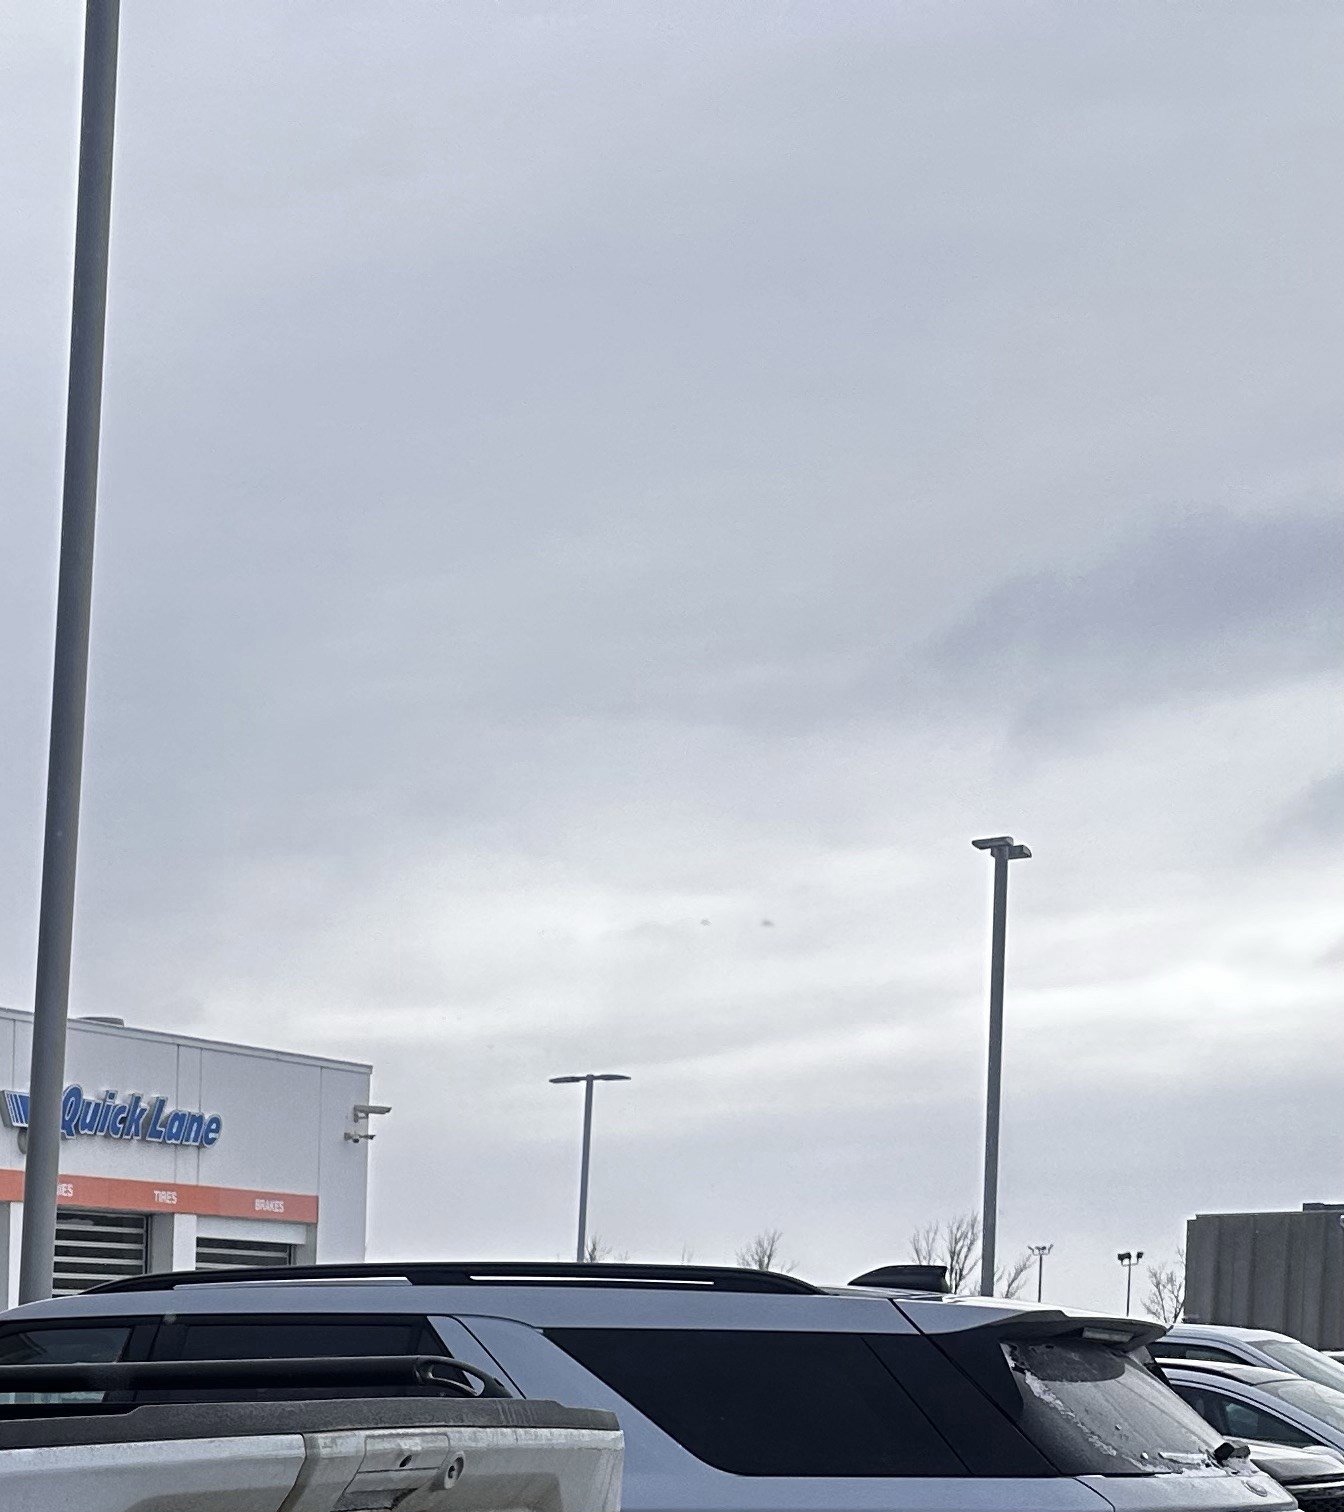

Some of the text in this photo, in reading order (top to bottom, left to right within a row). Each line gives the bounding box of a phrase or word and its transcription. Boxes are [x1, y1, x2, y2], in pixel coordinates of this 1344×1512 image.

[59, 1083, 222, 1148] Quick Lane
[153, 1190, 178, 1205] TIRES
[254, 1198, 285, 1213] BRAKES
